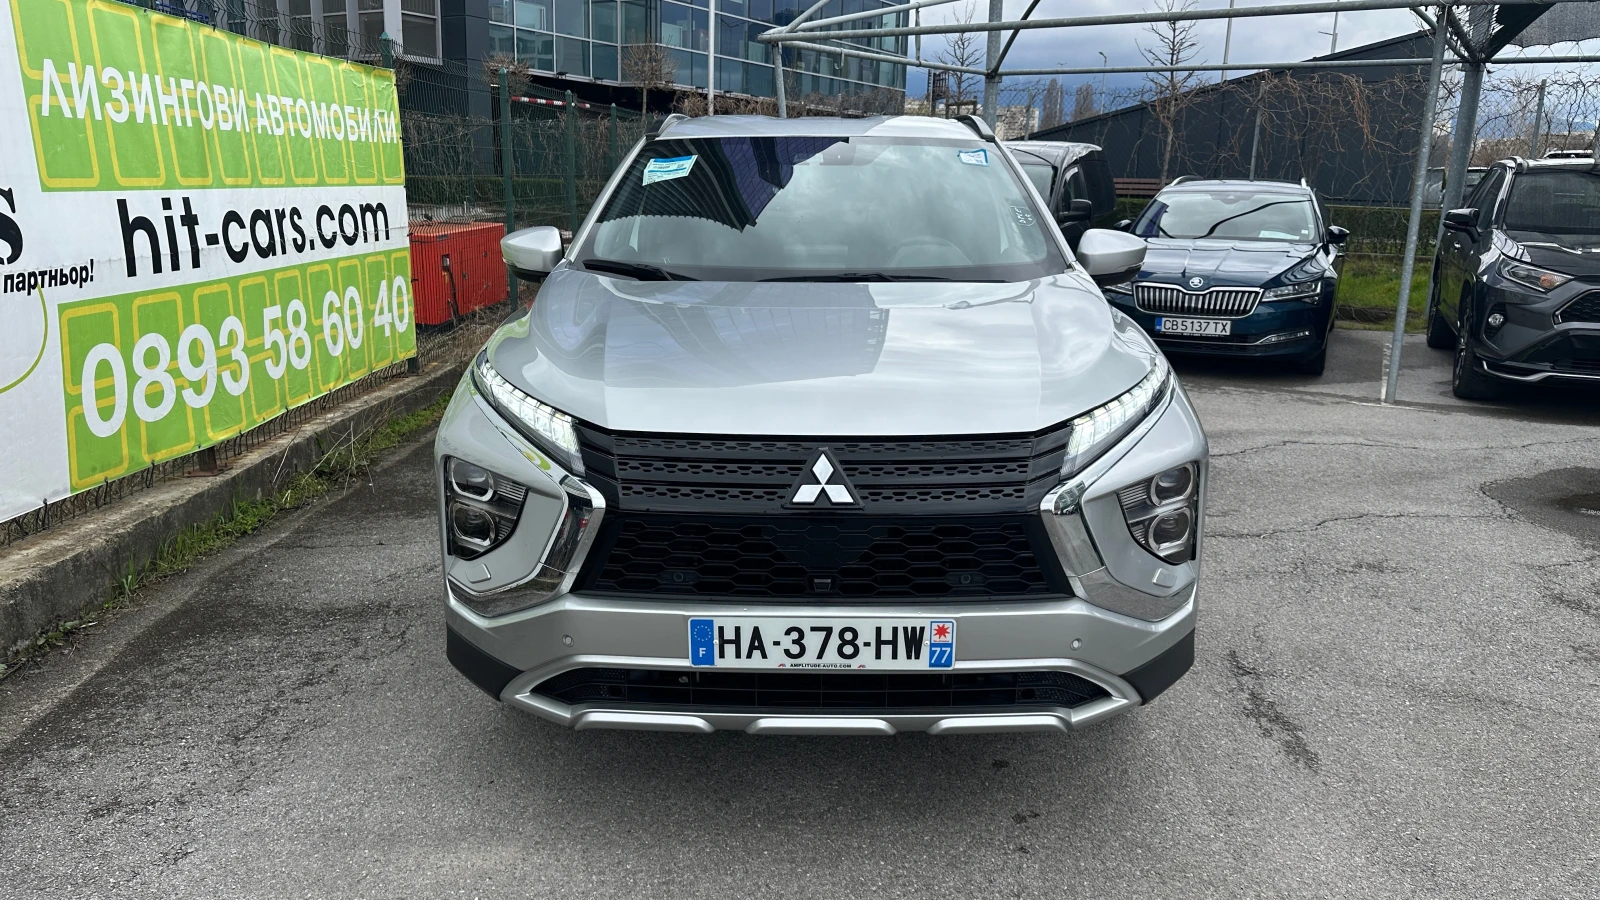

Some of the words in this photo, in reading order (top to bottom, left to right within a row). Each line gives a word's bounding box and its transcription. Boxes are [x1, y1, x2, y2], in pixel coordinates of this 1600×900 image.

[41, 58, 250, 132] ЛИЗИНГОВИ
[255, 91, 398, 144] АВТОМОБИЛИ
[116, 196, 391, 277] hit-cars.com
[3, 258, 94, 296] партньор!
[1163, 319, 1179, 331] CB
[1180, 320, 1211, 333] 5137
[1212, 322, 1229, 334] TX
[82, 315, 249, 437] 0893
[263, 298, 311, 380] 58
[322, 285, 364, 357] 60
[373, 275, 409, 338] 40
[698, 647, 707, 658] F
[717, 625, 926, 660] HA-378-HW
[931, 646, 951, 664] 77
